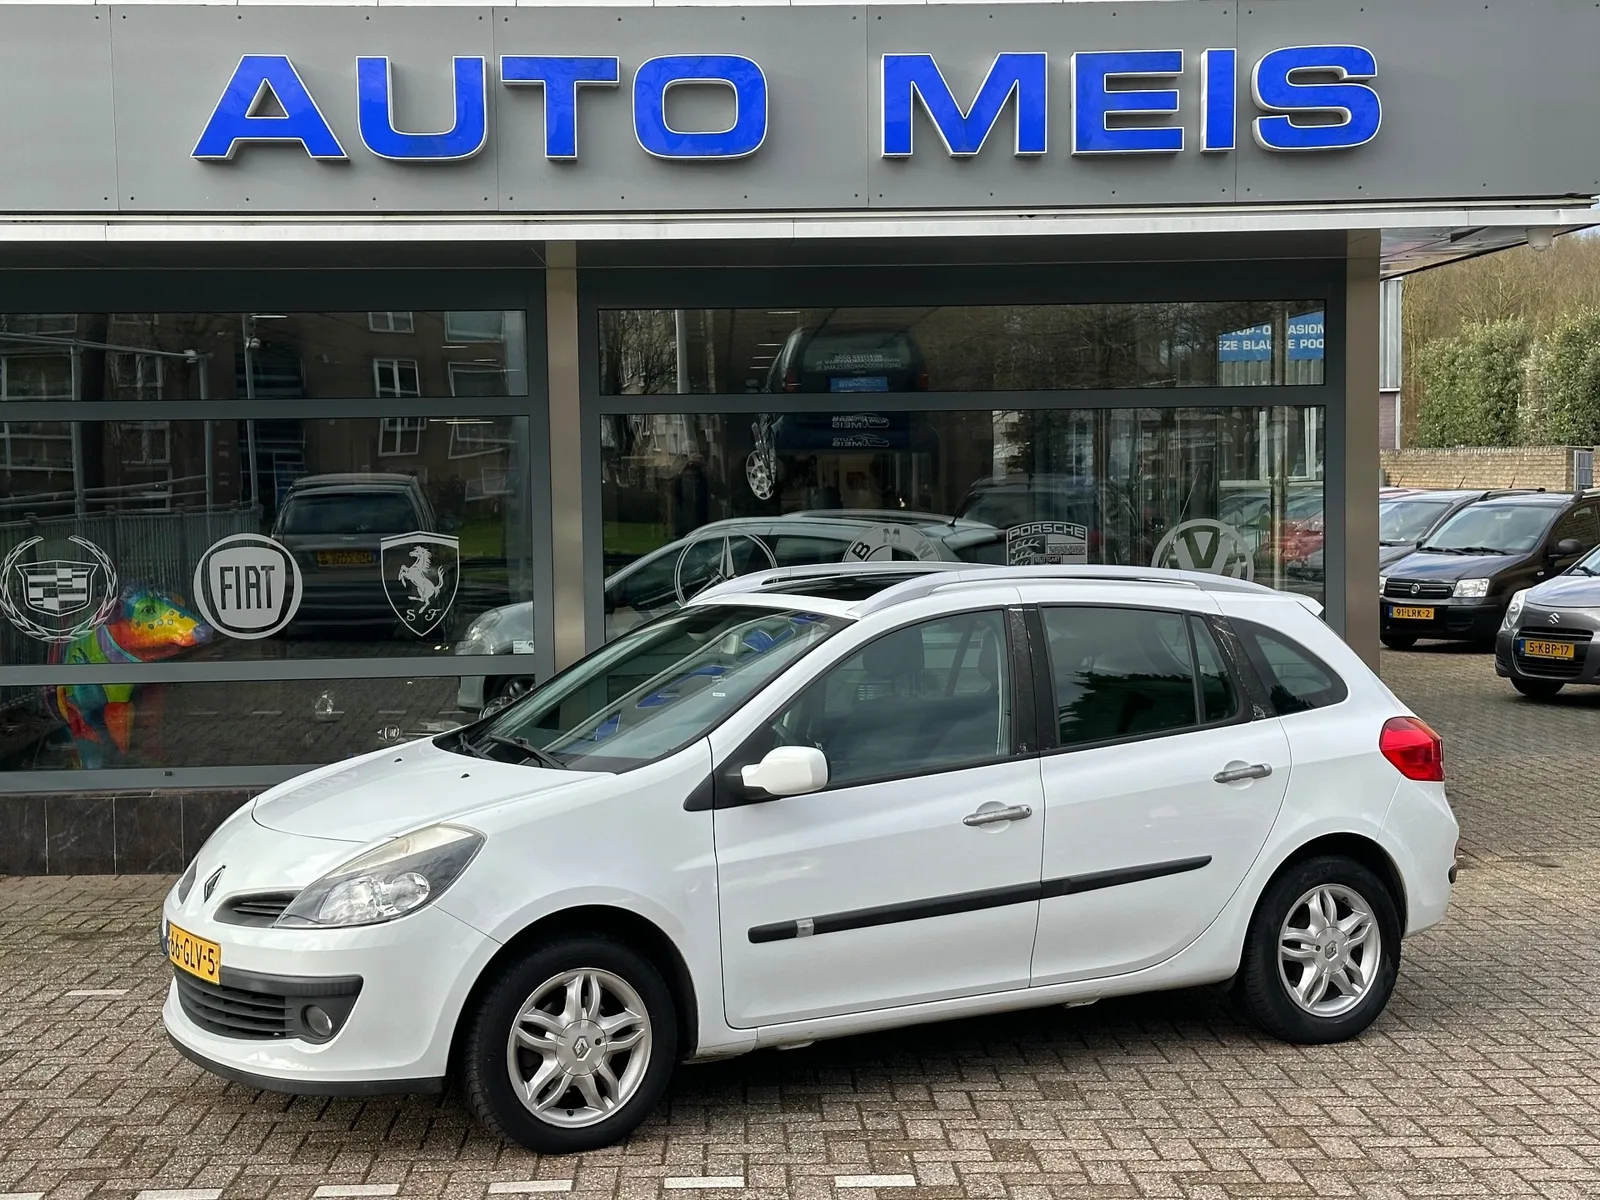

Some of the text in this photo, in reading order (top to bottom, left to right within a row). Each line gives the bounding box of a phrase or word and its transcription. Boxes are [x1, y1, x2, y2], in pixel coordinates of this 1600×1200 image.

[190, 44, 1382, 161] AUTO MEIS
[1009, 523, 1085, 540] PORSCHE
[219, 565, 276, 611] FIAT
[1396, 608, 1431, 618] 91-LRK-2
[1529, 642, 1570, 656] 5-KBP-17
[170, 930, 215, 976] 66-GLV-5
